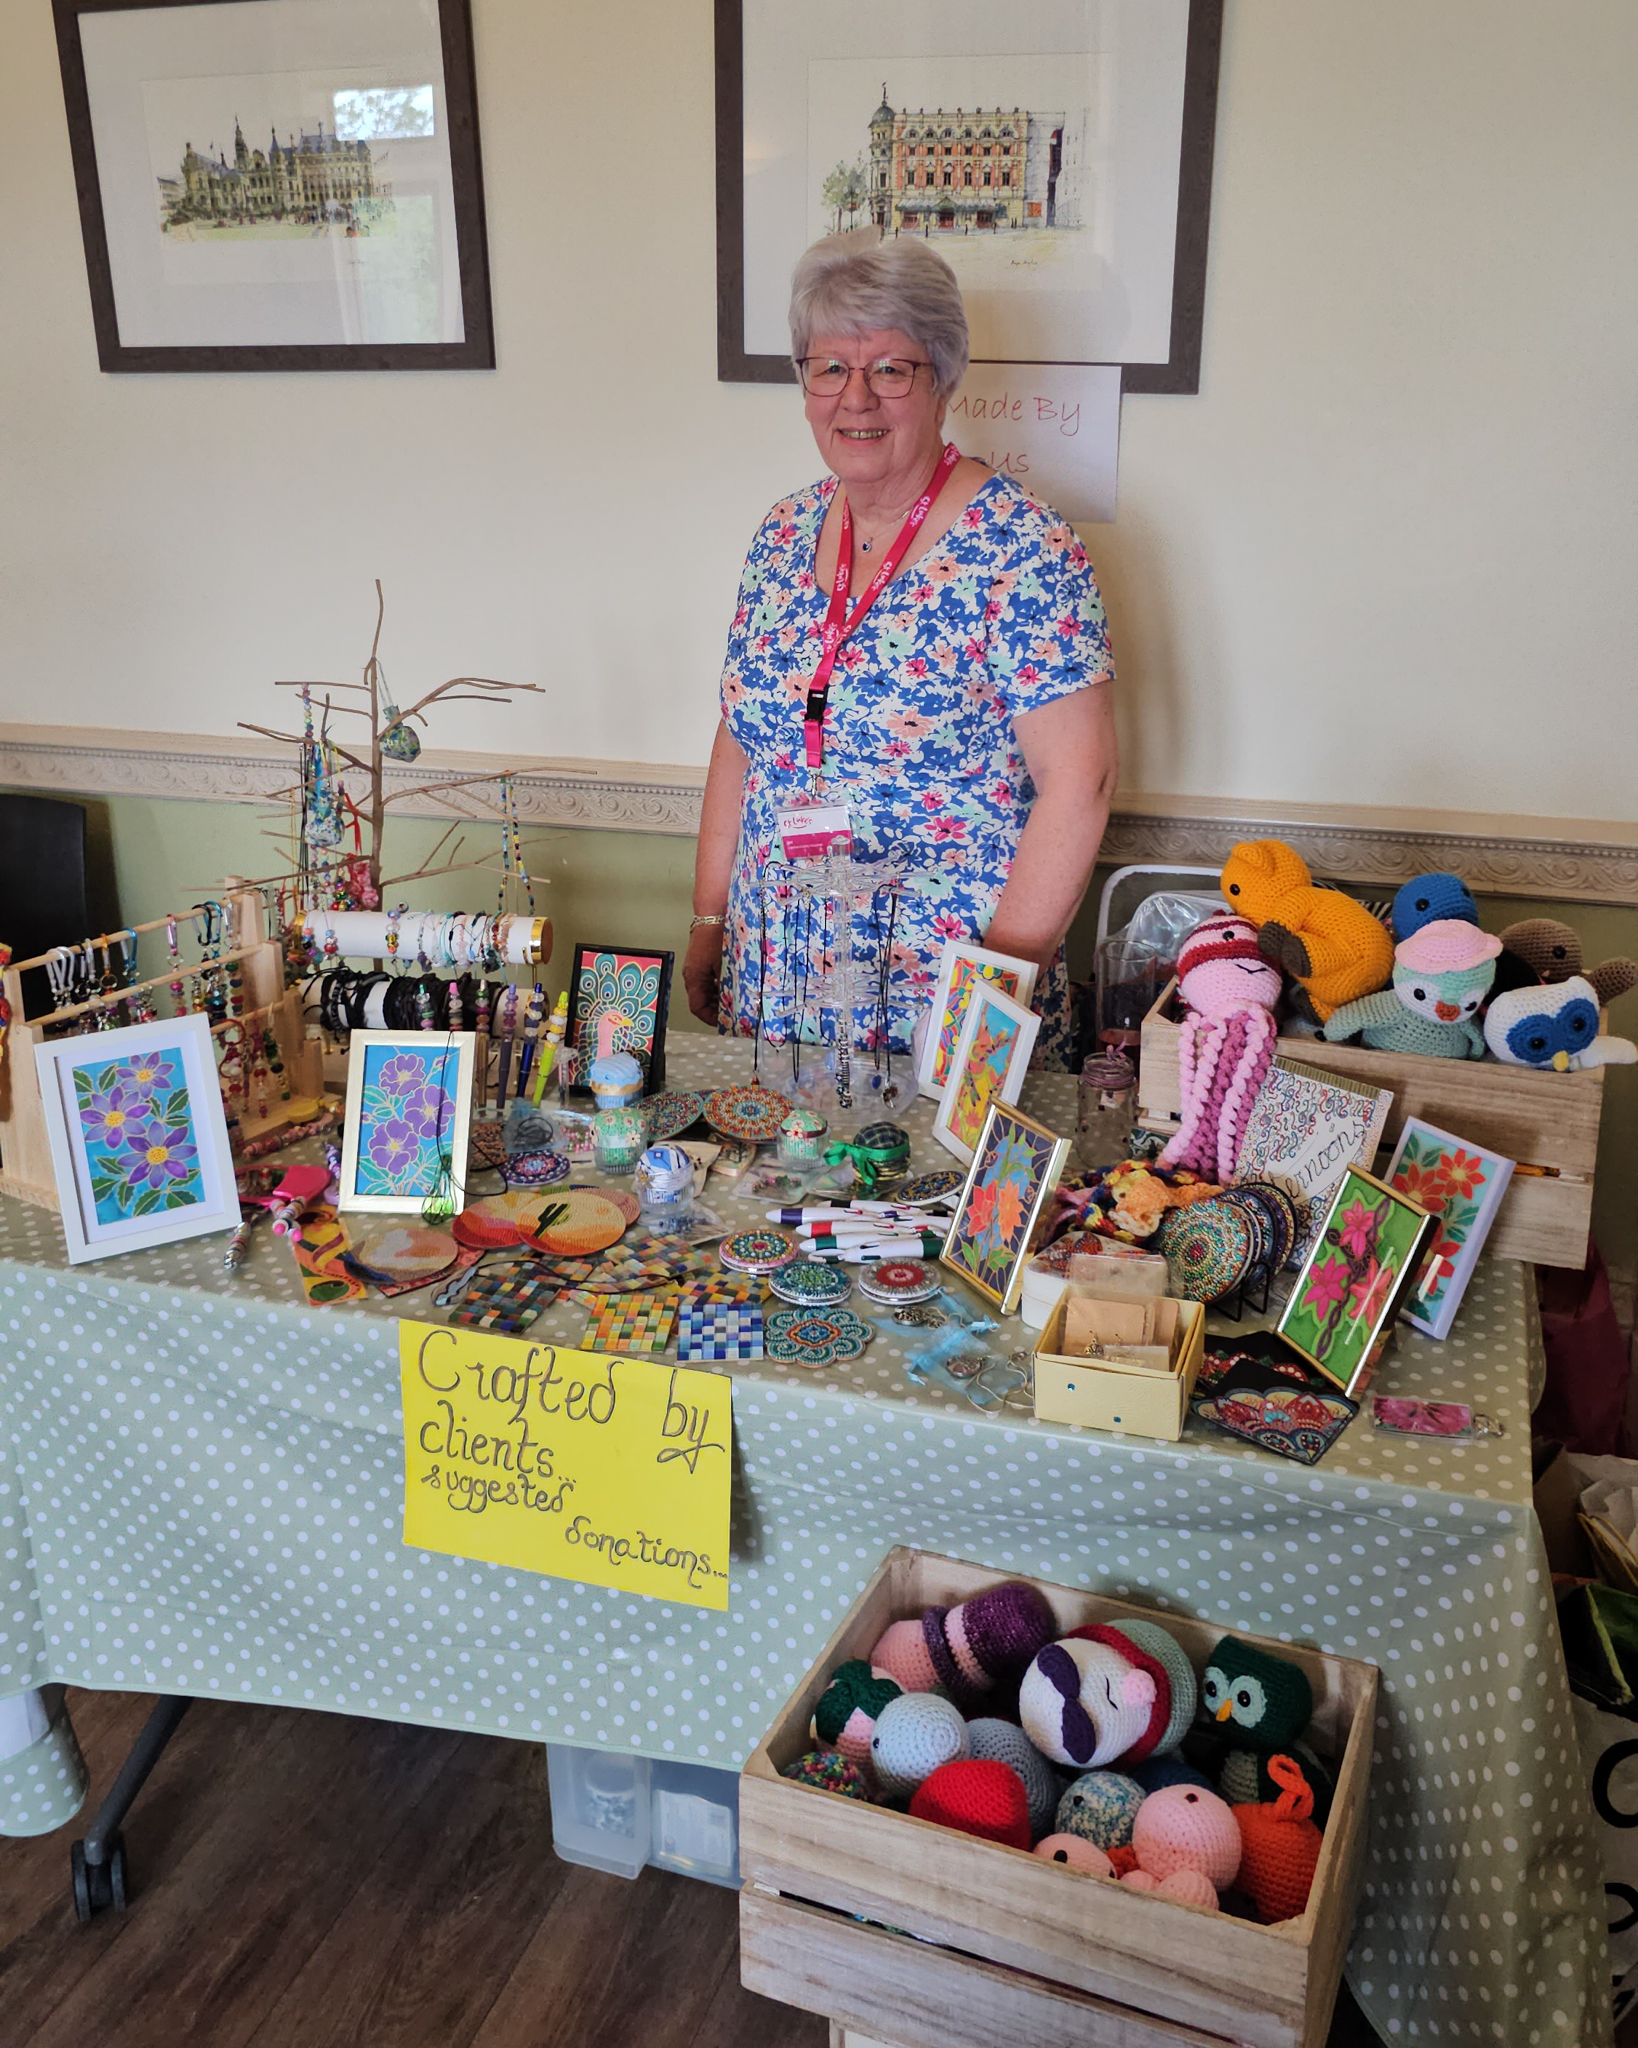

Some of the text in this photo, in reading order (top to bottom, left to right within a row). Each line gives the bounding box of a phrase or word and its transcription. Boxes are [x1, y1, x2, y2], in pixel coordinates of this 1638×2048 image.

[1033, 397, 1080, 436] By
[418, 1330, 725, 1474] Crafted by
